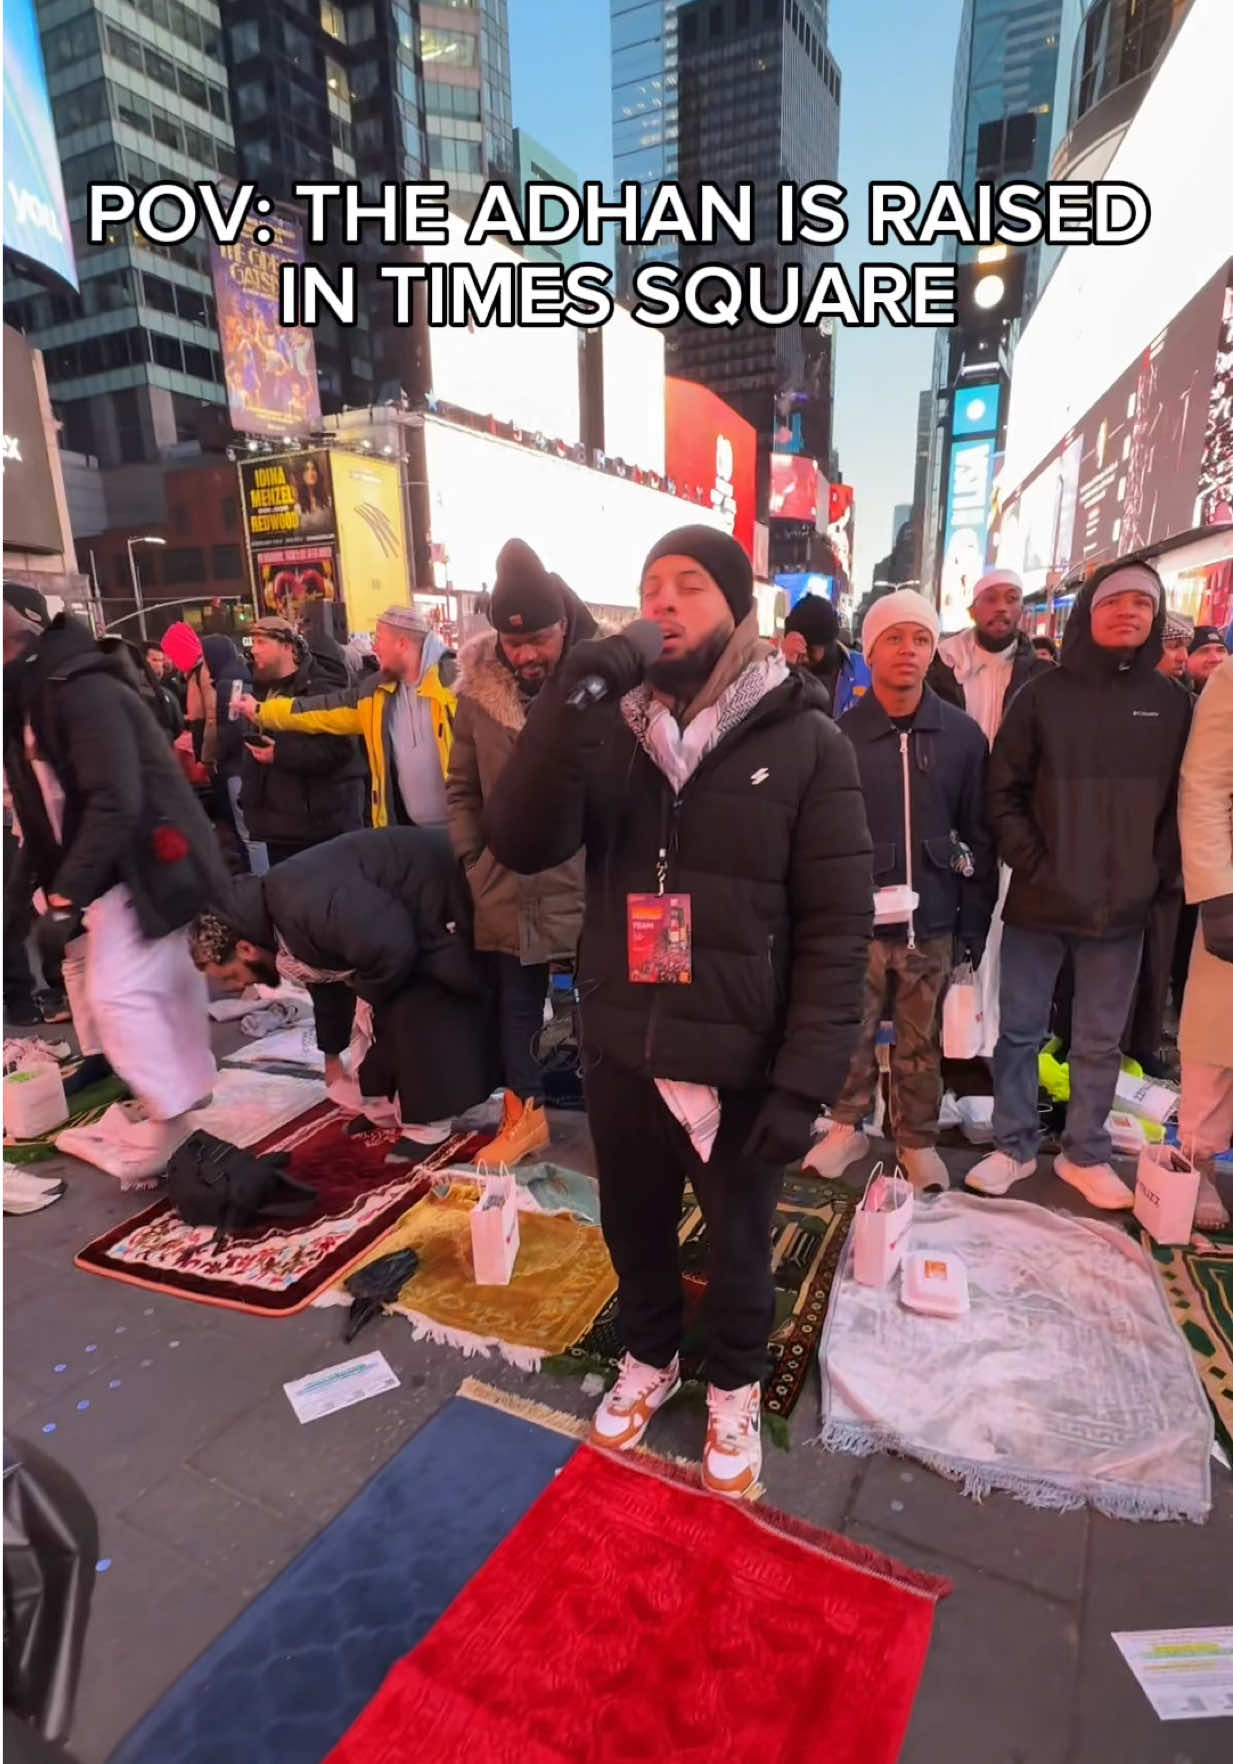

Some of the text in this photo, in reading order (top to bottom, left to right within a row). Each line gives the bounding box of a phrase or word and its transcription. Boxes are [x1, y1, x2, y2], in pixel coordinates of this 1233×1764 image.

[254, 466, 286, 489] IDINA
[250, 485, 295, 509] MENZEL
[250, 511, 300, 533] REDWOOD
